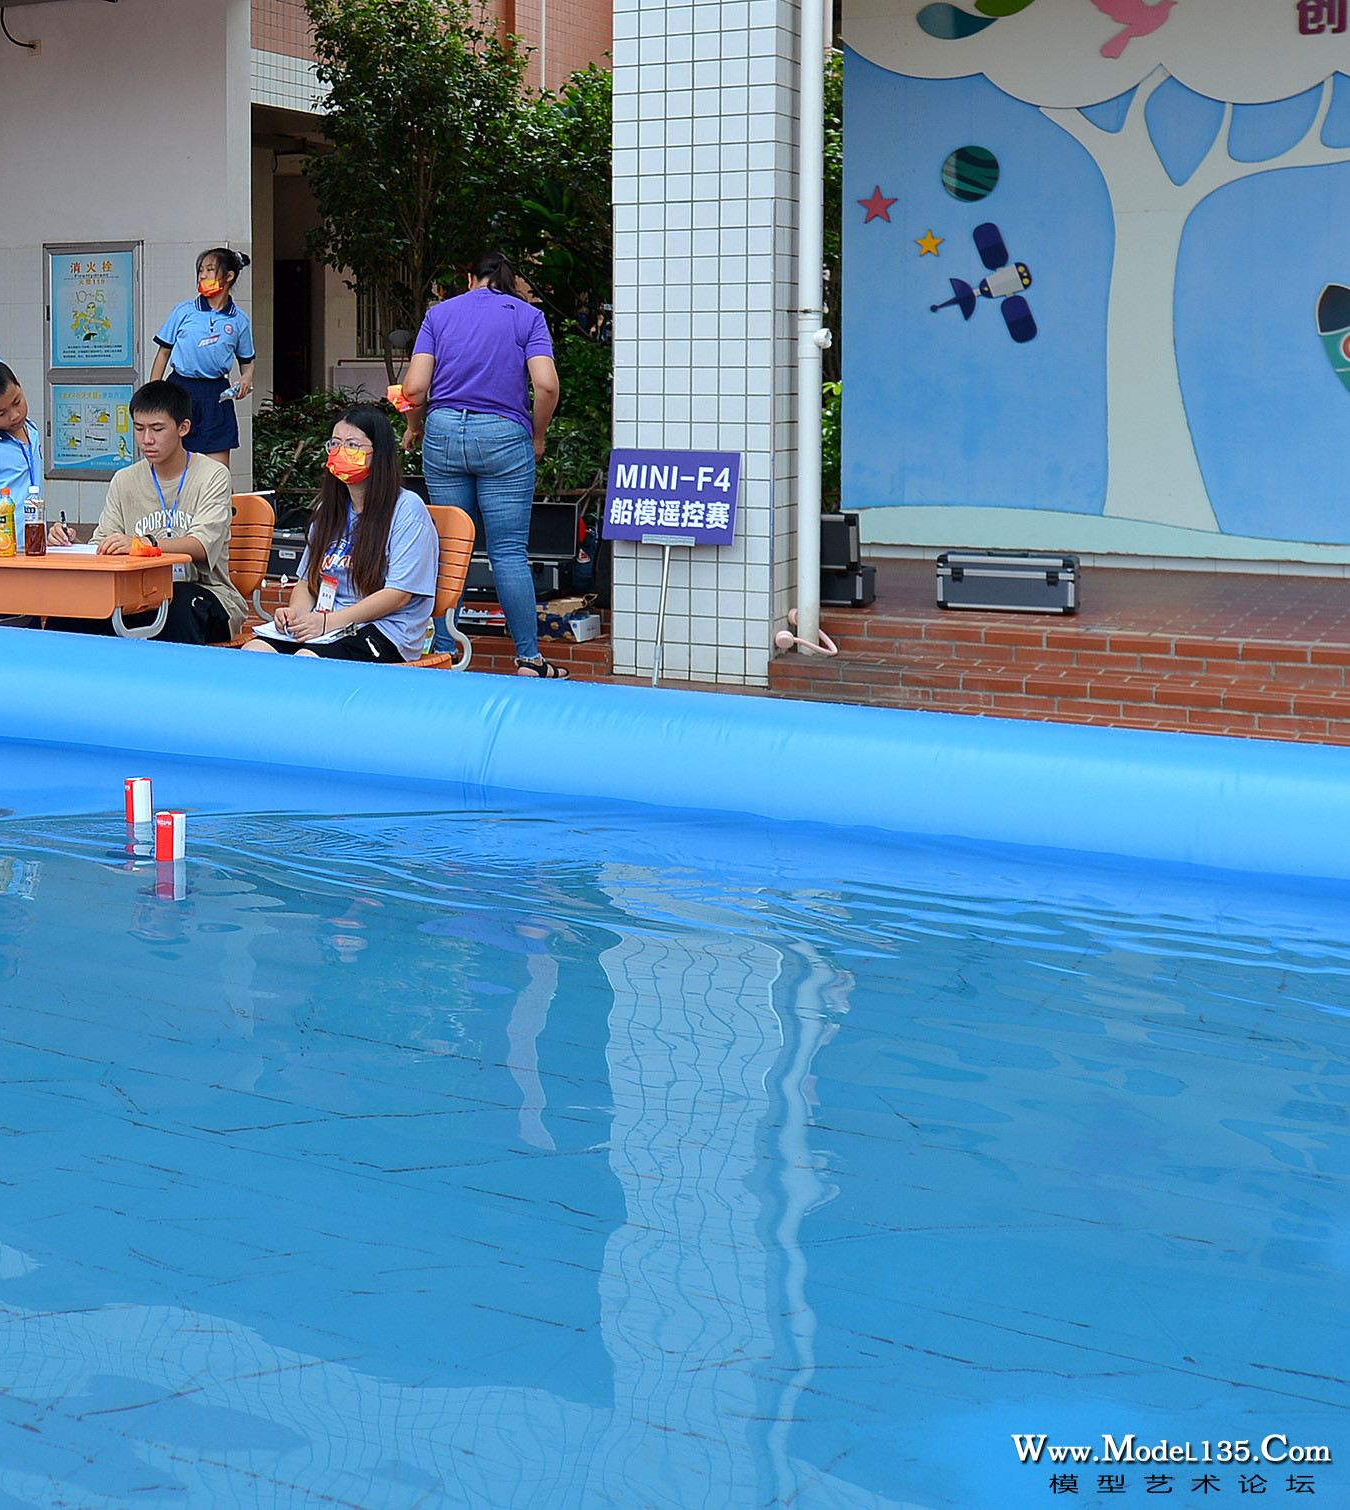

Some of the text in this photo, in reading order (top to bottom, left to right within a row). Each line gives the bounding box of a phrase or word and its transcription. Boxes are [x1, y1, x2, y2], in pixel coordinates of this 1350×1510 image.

[1297, 0, 1347, 35] 创
[70, 260, 113, 274] 消火栓
[615, 464, 731, 493] MINI-F4
[609, 497, 731, 530] 船模遥控赛
